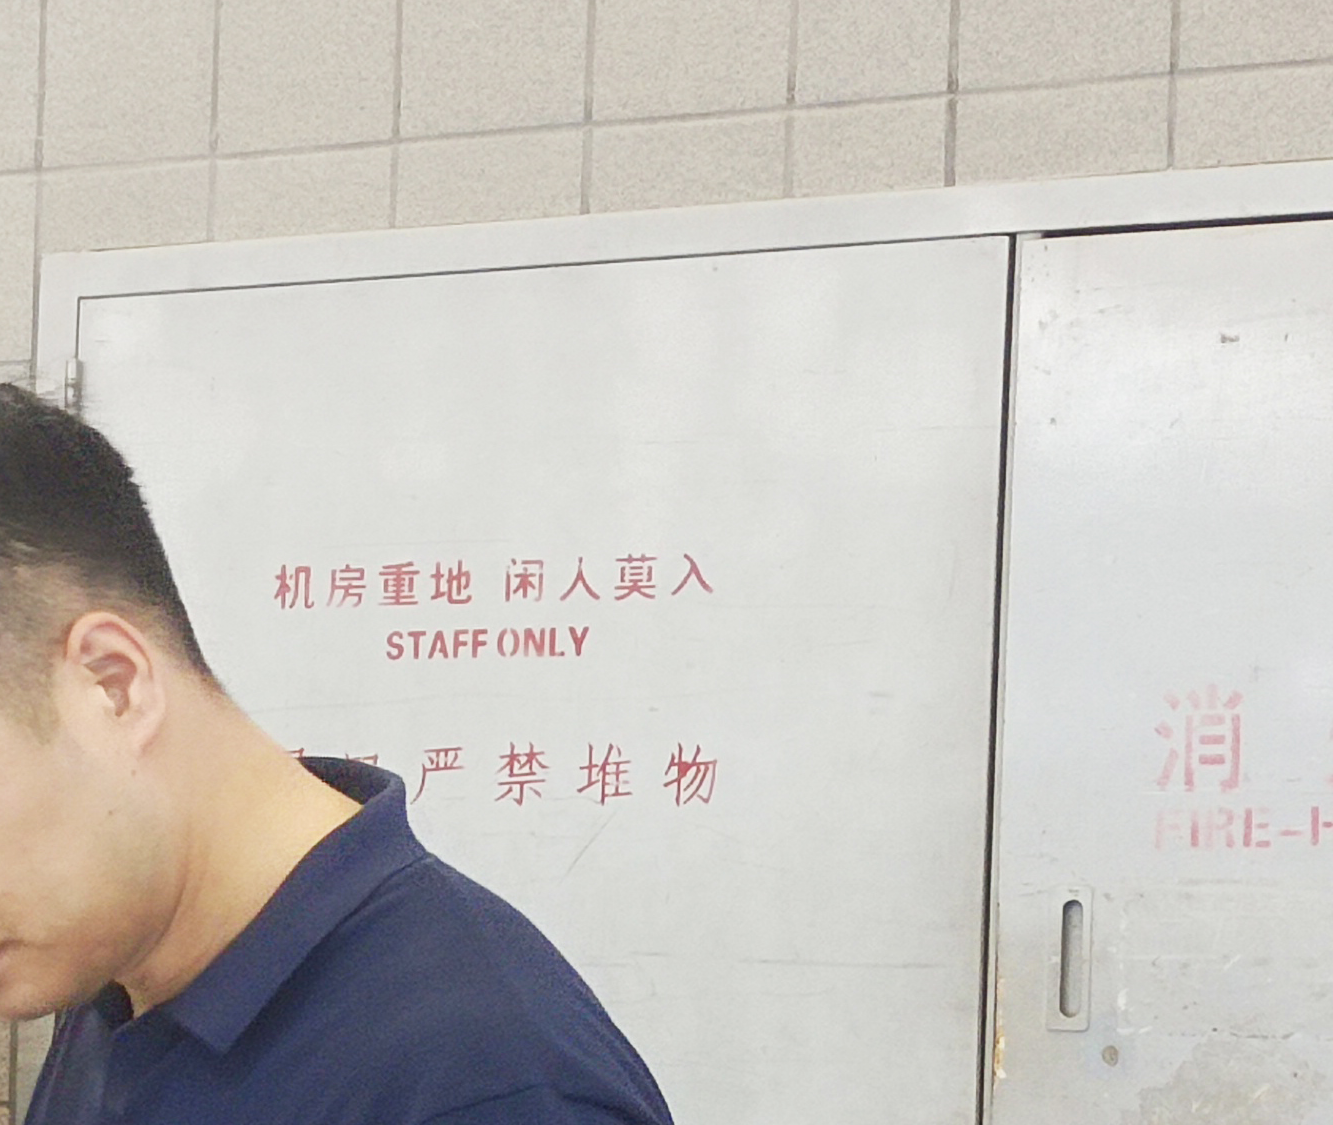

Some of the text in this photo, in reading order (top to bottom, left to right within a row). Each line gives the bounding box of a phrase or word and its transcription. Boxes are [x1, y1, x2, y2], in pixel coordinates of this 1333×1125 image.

[274, 553, 714, 609] 机房重地 闲人莫入
[385, 626, 590, 661] STAFF ONLY
[287, 741, 718, 807] 严禁堆物
